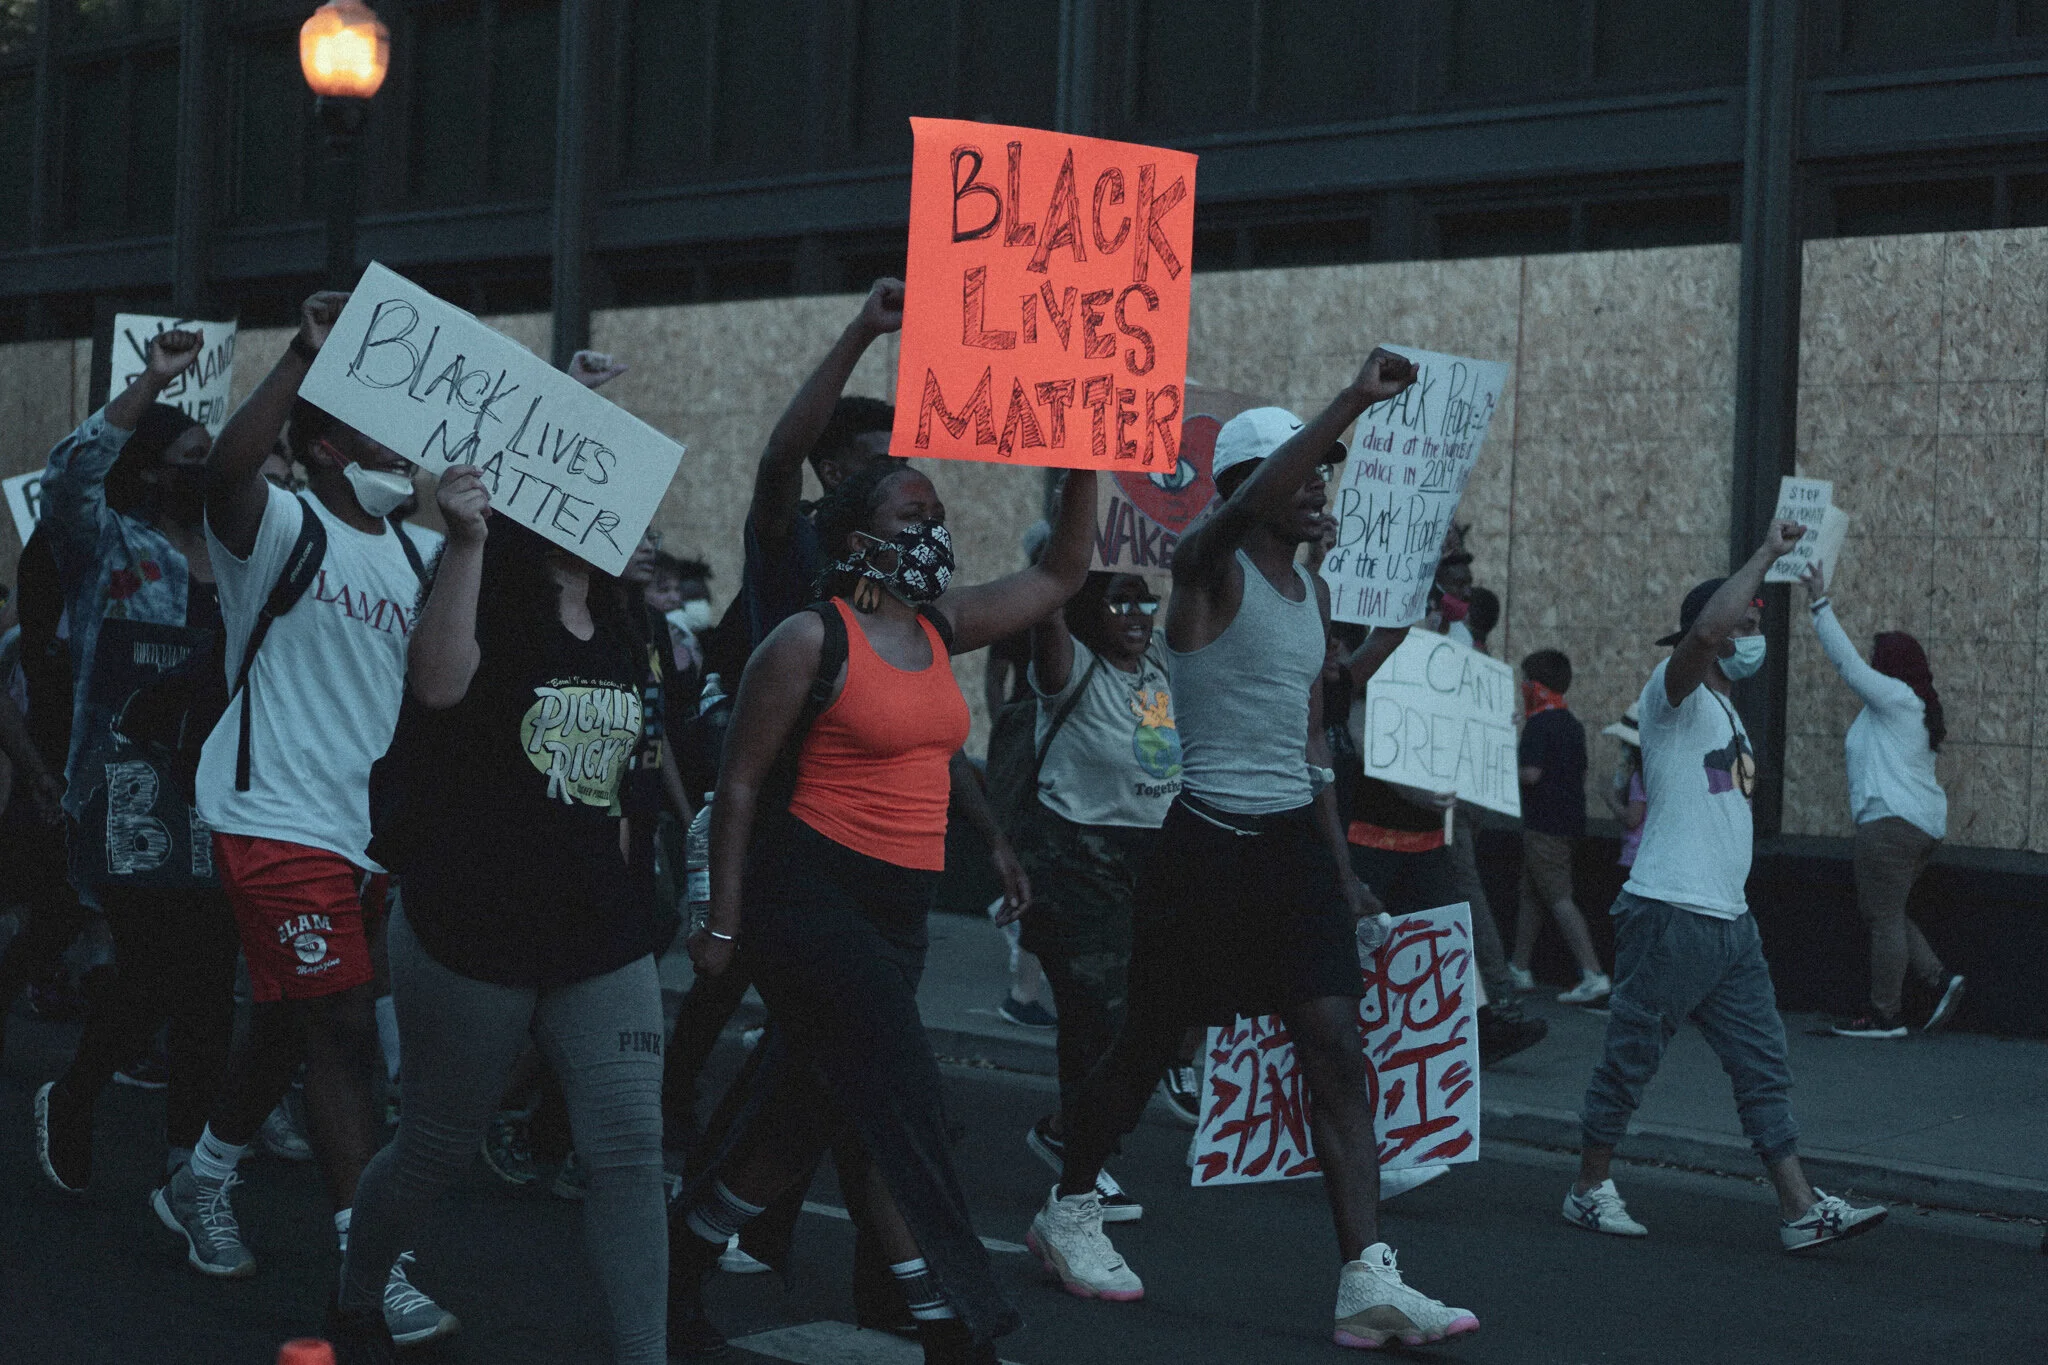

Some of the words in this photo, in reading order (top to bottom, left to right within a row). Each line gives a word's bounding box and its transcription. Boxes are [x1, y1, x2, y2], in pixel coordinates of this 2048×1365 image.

[951, 141, 1187, 282] BLACK
[962, 265, 1159, 376] LIVES
[346, 299, 520, 430] BLACK
[506, 395, 617, 485] LIVES
[915, 366, 1181, 468] MATTER
[421, 419, 623, 556] MATTER
[1420, 459, 1455, 489] 2019
[1328, 548, 1350, 573] of
[1374, 632, 1425, 688] I
[528, 687, 642, 754] PICKLE
[1371, 697, 1519, 806] BREATHE
[543, 737, 636, 805] RICK'S
[619, 1031, 661, 1057] PINK
